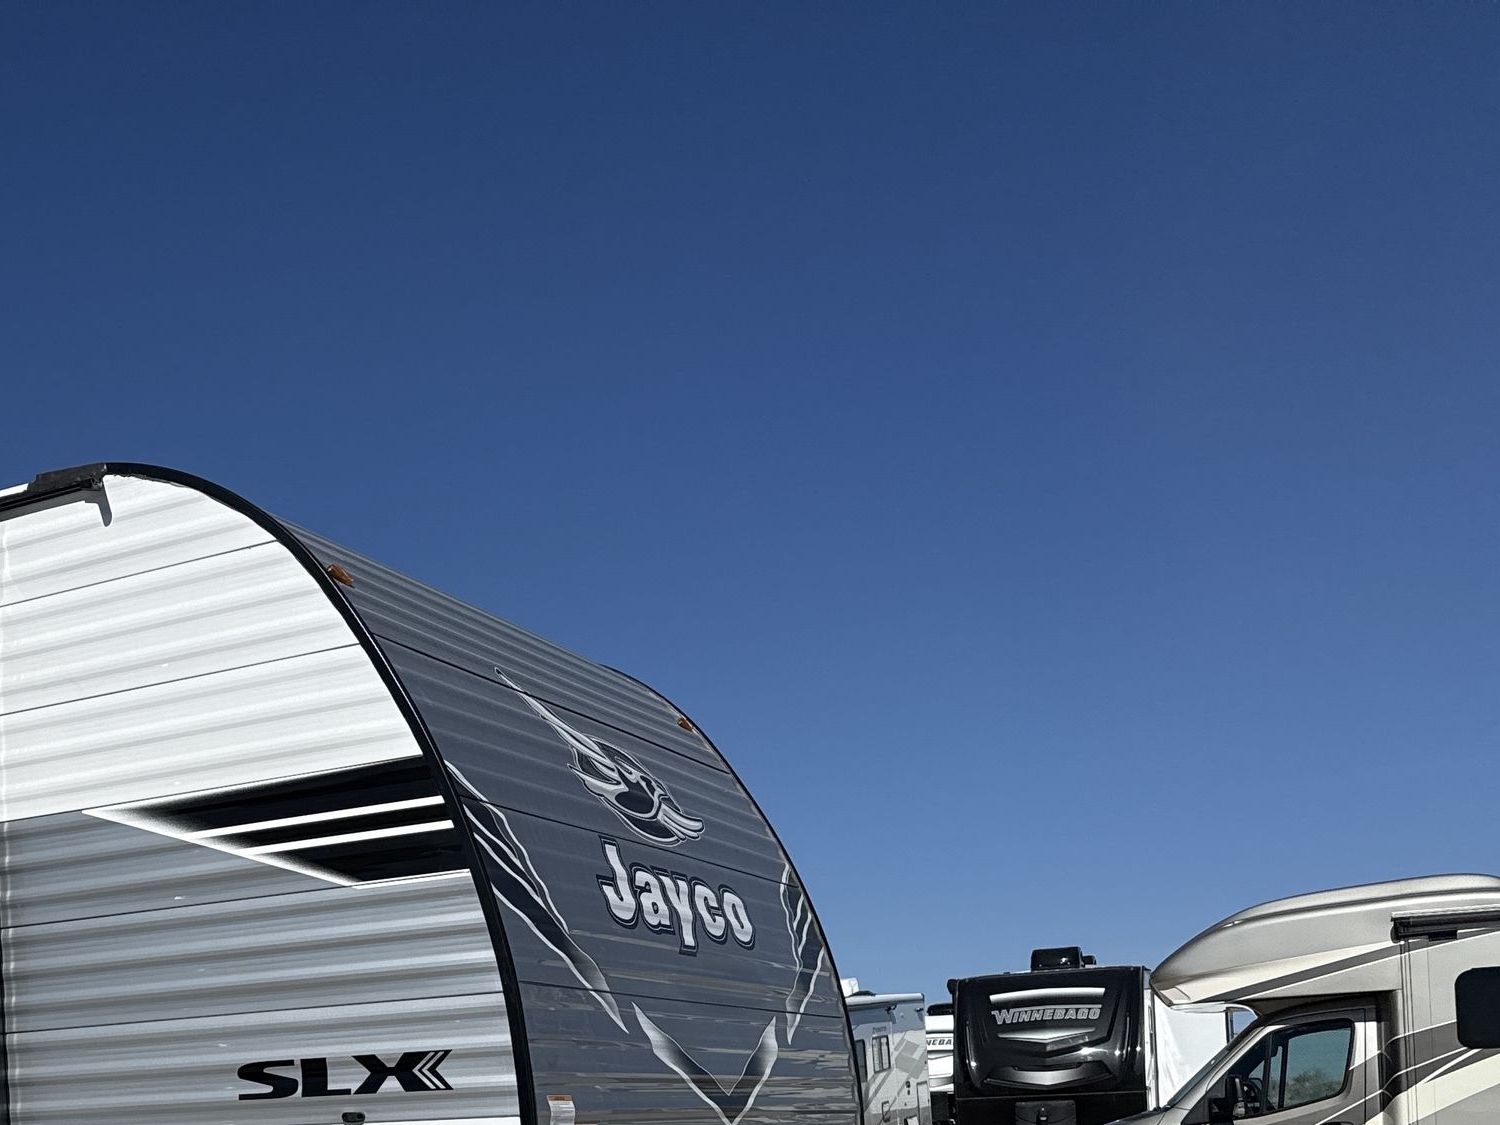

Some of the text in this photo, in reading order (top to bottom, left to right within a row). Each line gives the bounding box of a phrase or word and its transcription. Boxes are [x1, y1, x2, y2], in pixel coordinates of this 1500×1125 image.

[597, 836, 755, 955] Jayco
[991, 1004, 1102, 1025] WINNEBAGO
[237, 1049, 454, 1100] SLX
